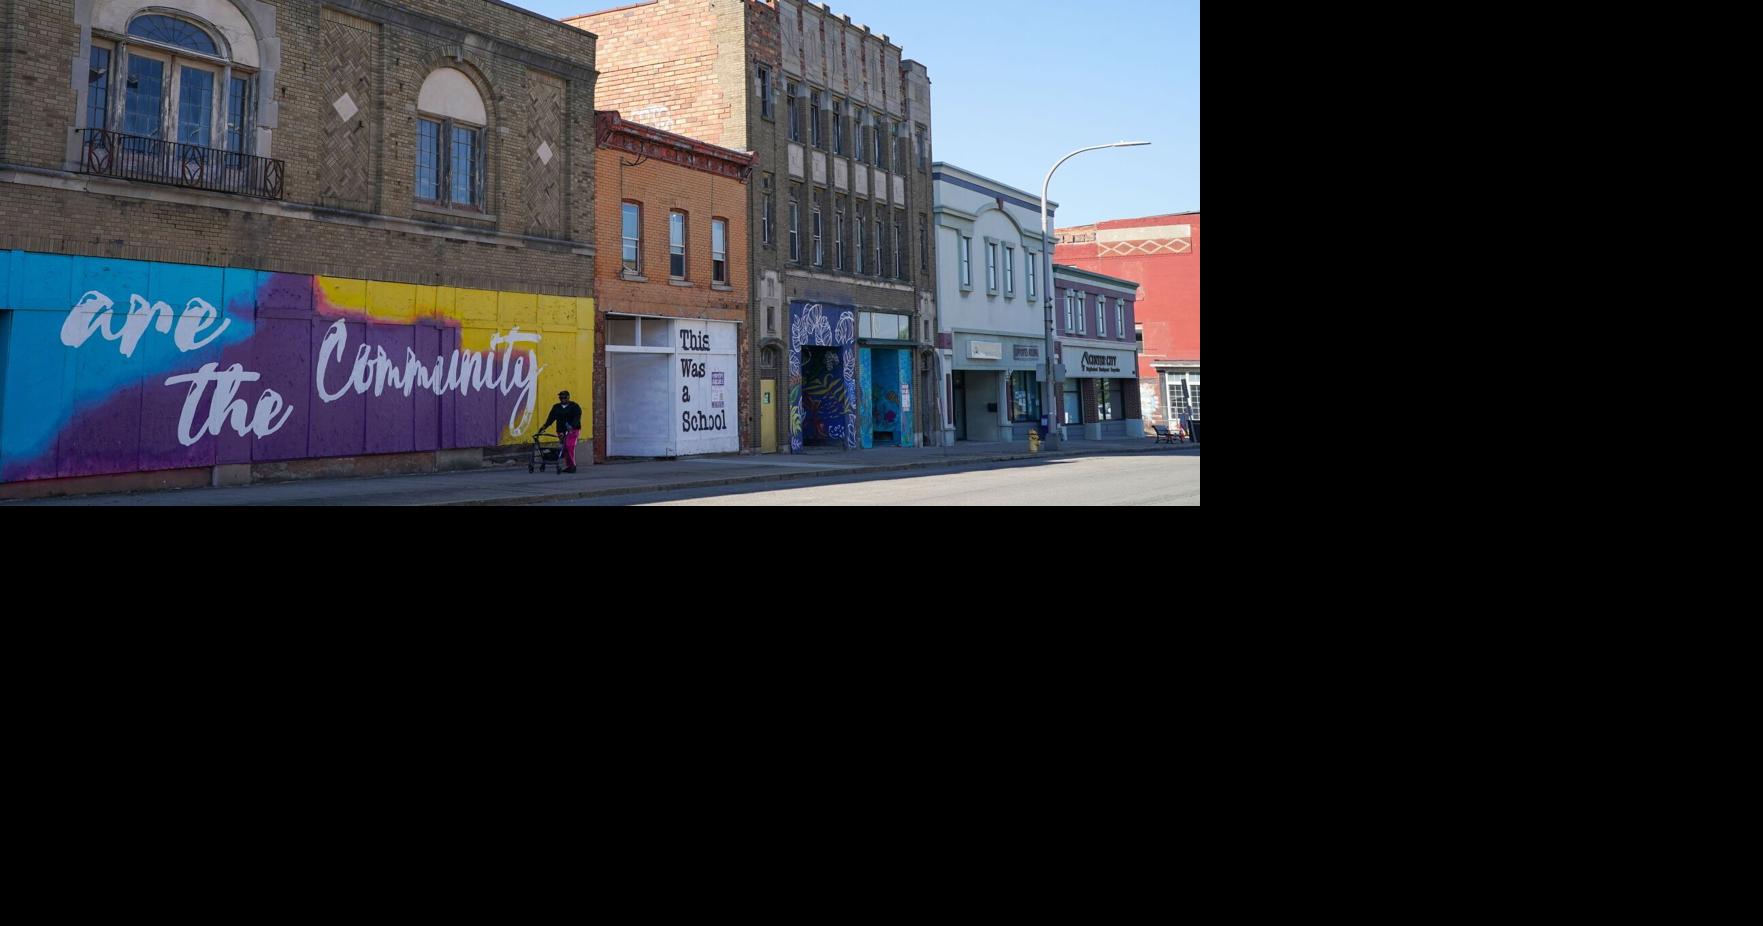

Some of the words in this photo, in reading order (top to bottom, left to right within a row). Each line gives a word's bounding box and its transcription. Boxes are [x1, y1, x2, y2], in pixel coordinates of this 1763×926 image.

[60, 290, 231, 358] are
[680, 329, 710, 351] This
[316, 318, 547, 437] Community
[680, 358, 706, 378] Was
[164, 362, 294, 446] the
[682, 385, 690, 402] a
[682, 409, 727, 432] School
